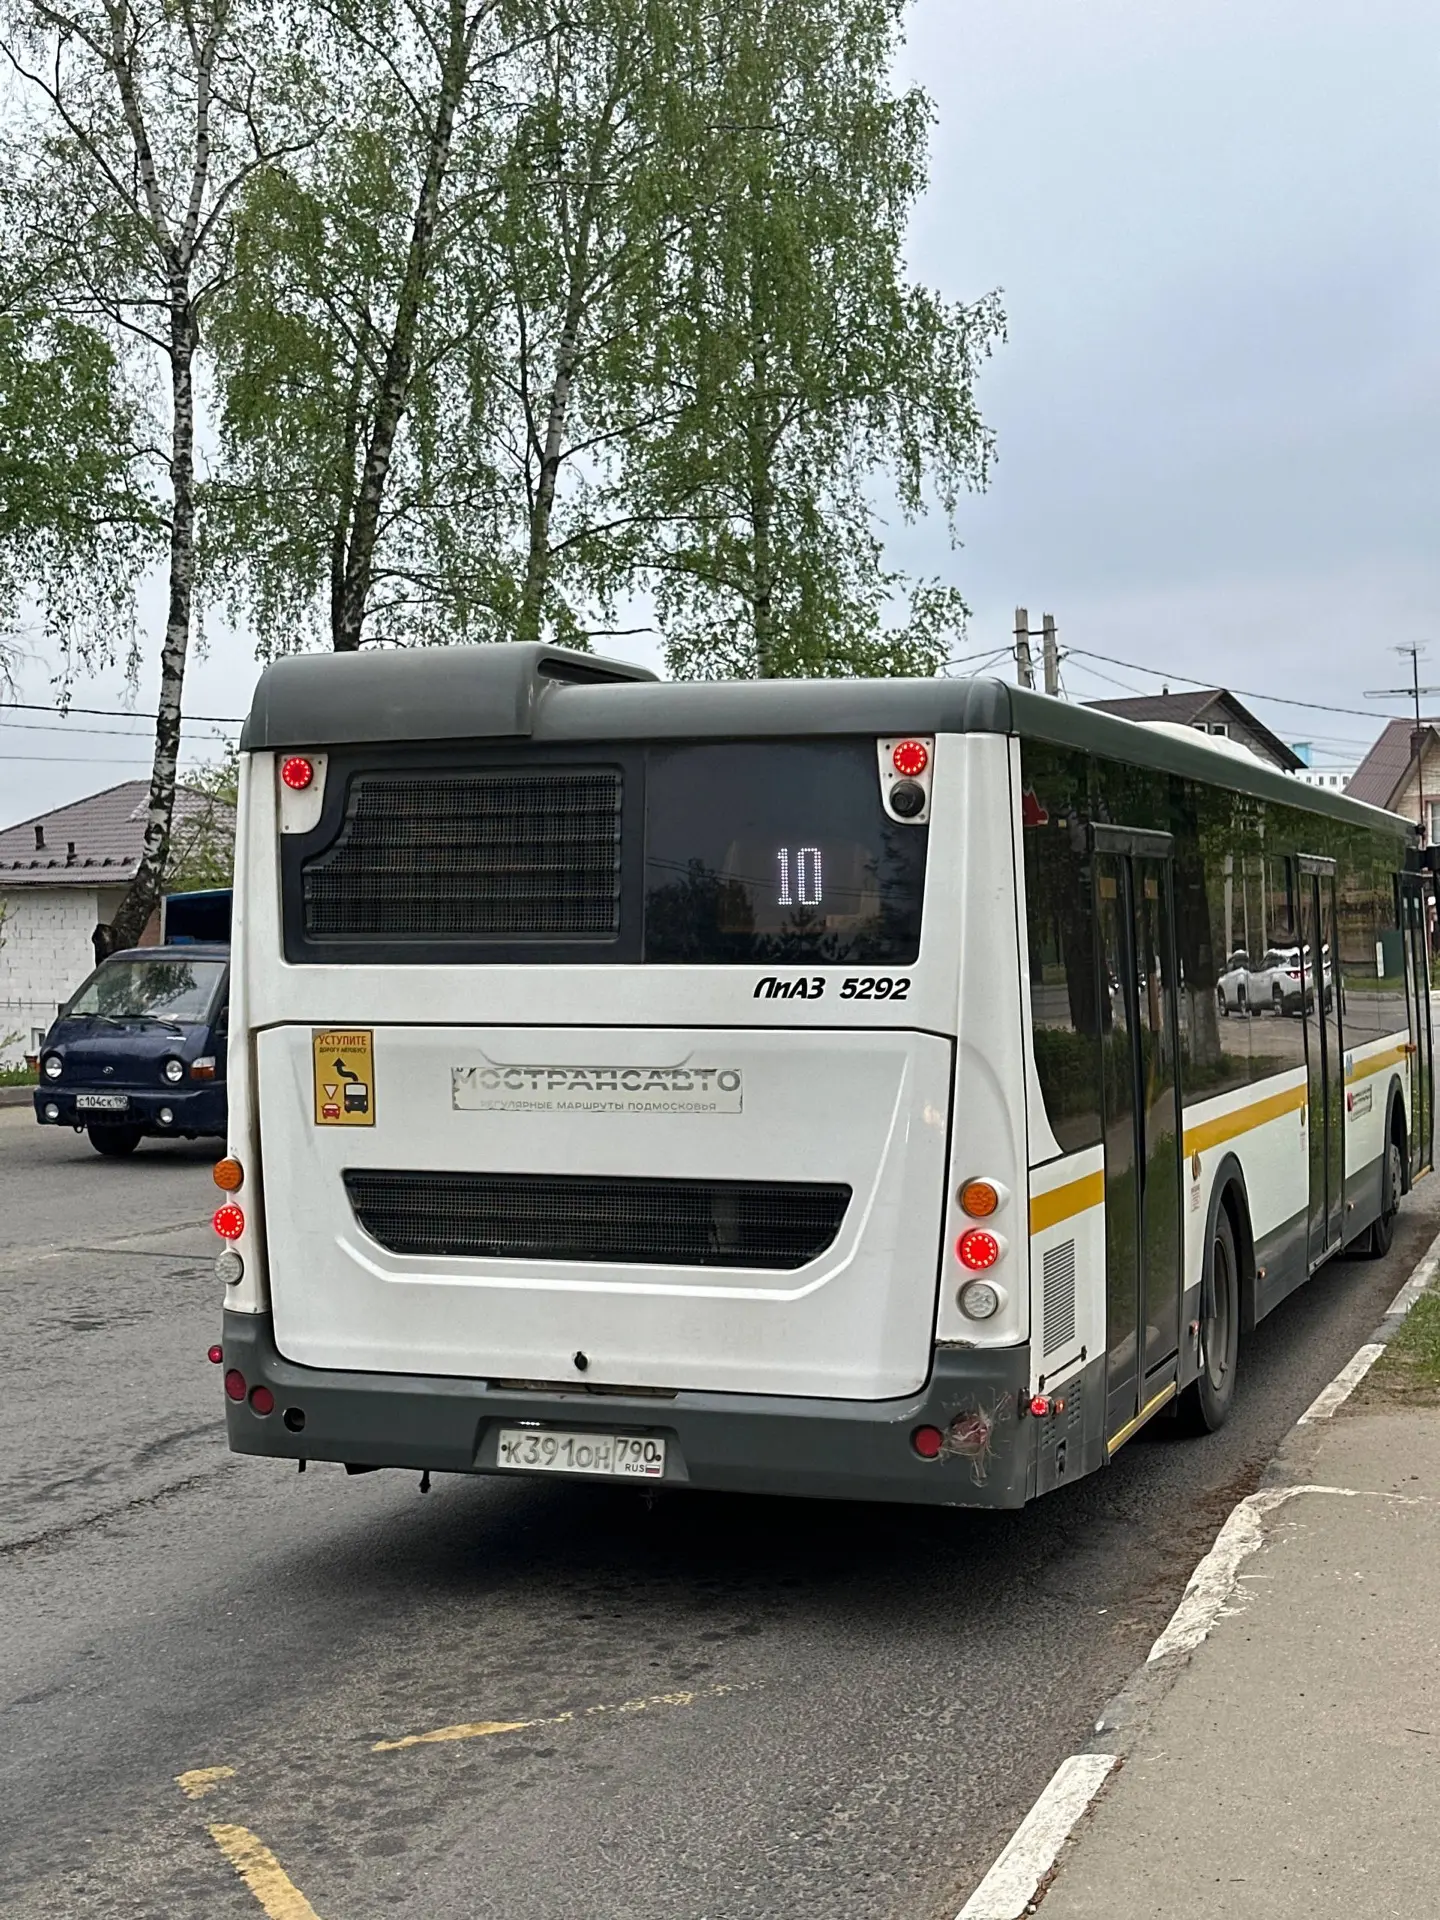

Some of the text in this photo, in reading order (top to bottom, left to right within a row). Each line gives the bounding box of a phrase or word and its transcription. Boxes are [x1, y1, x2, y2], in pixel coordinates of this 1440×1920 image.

[776, 847, 823, 906] 10
[839, 977, 912, 1001] 5292
[318, 1034, 367, 1046] УСТУПИТЕ
[557, 1101, 624, 1111] МАРШРУТЫ
[628, 1102, 717, 1111] ПОДМОСКОВЬЯ
[616, 1438, 657, 1463] 790
[625, 1463, 645, 1473] RUS
